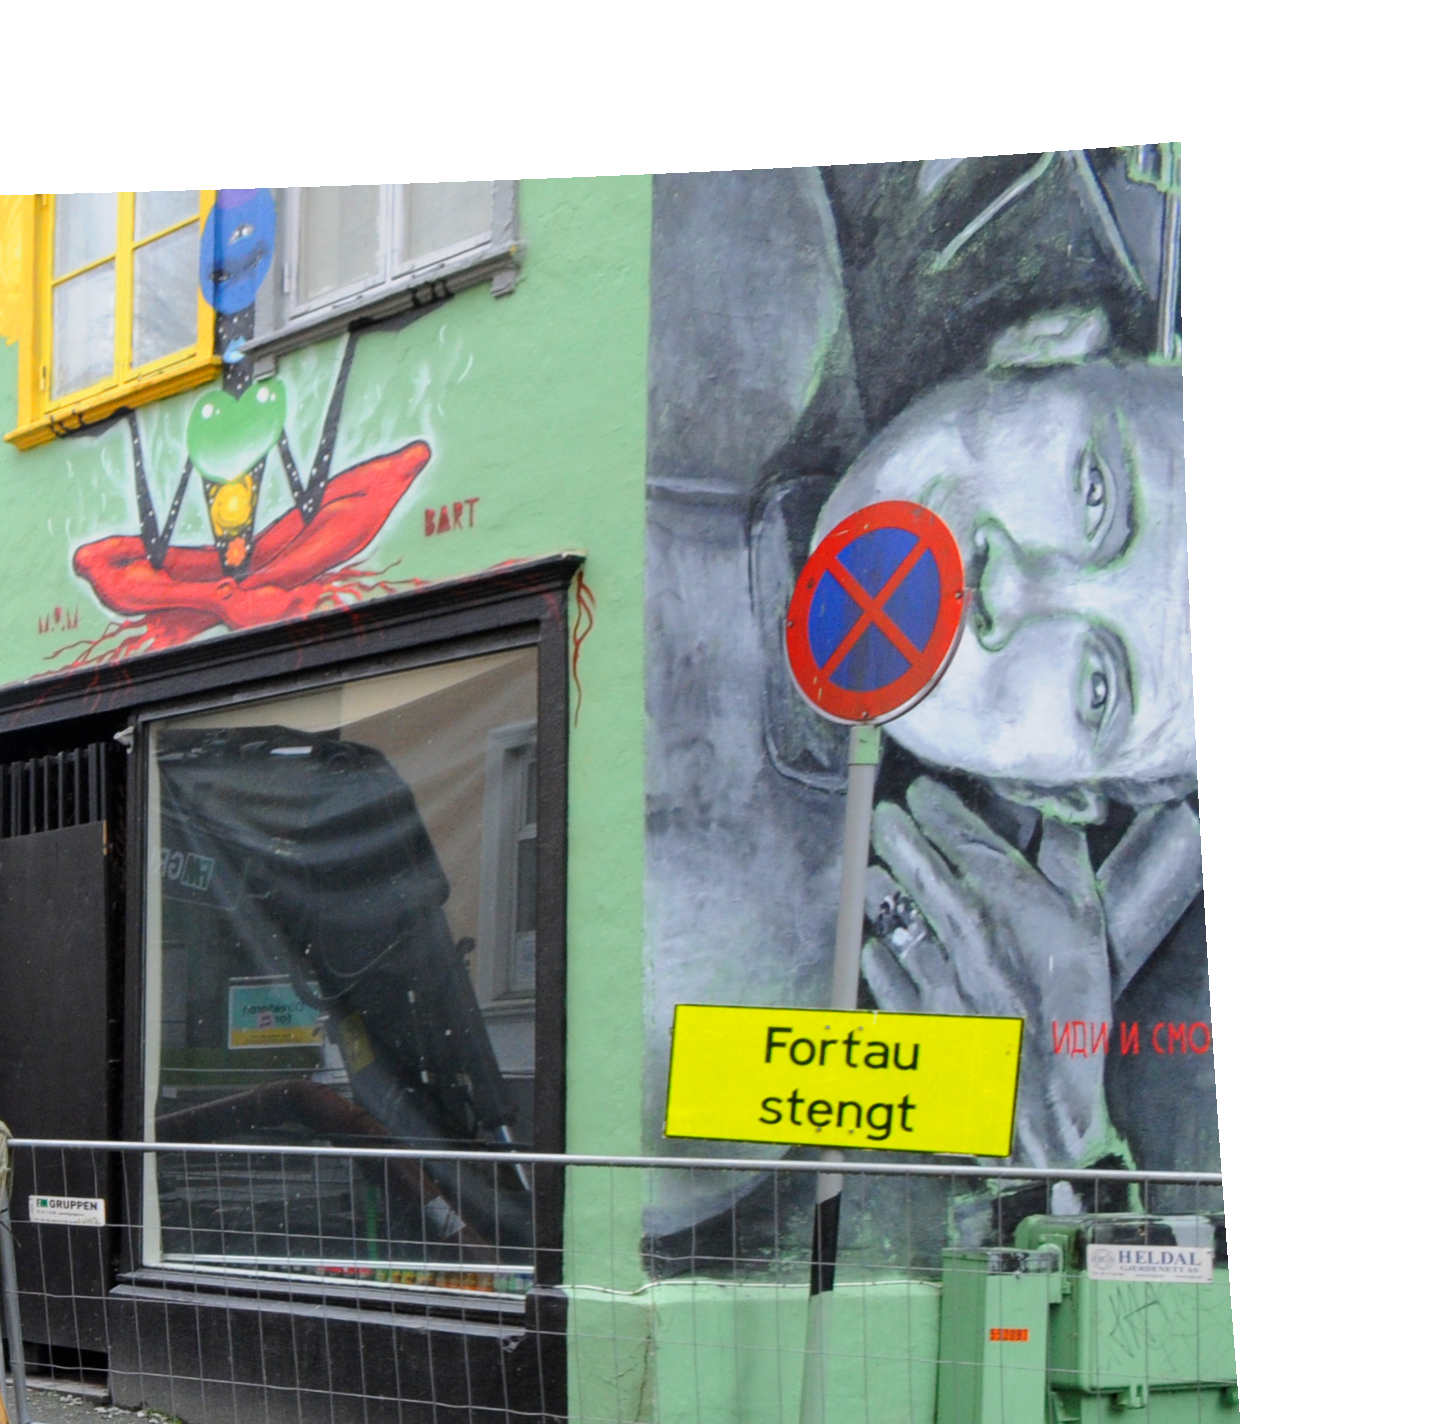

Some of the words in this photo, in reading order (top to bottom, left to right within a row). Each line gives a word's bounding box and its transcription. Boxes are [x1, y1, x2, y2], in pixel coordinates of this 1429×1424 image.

[424, 496, 480, 537] BART
[764, 1026, 920, 1071] Fortau
[1052, 1020, 1109, 1058] ИДИ
[1120, 1020, 1140, 1056] И
[758, 1088, 916, 1141] stengt
[49, 1199, 98, 1211] GRUPPEN
[1118, 1250, 1202, 1266] HELDAL
